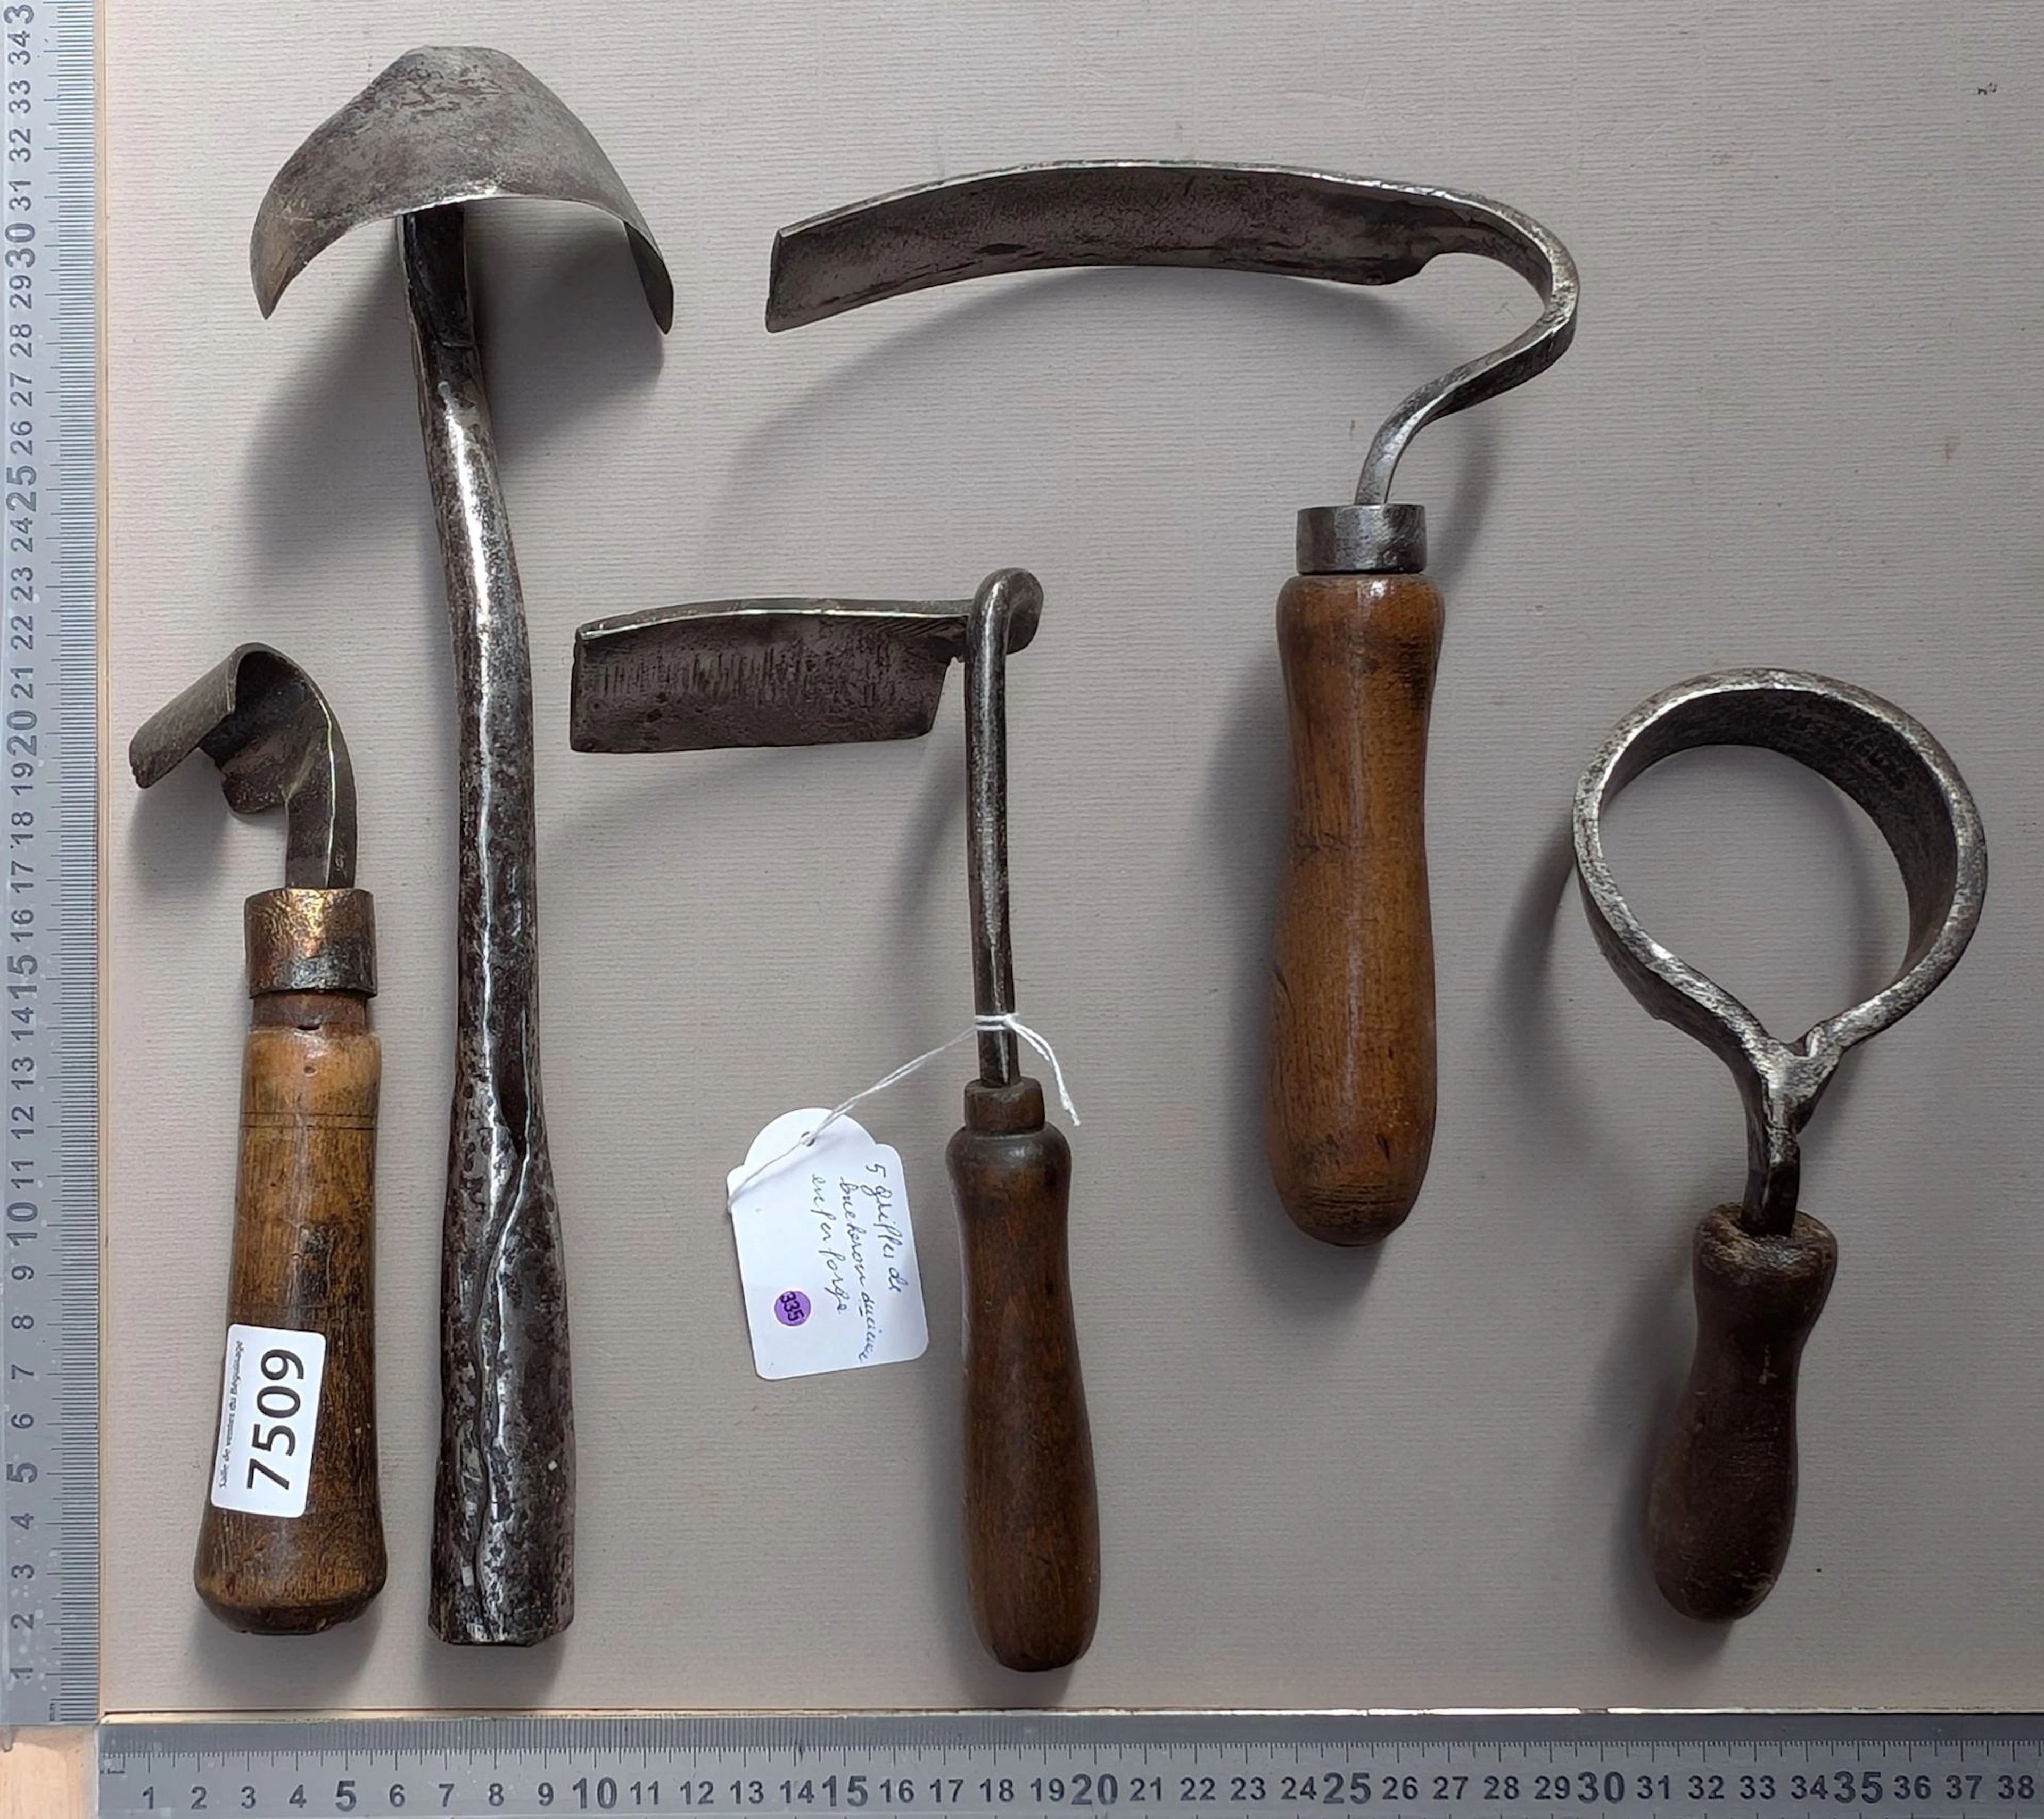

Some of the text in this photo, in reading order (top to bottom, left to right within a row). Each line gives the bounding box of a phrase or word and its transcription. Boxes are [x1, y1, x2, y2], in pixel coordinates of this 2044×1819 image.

[7, 30, 31, 65] 34
[8, 80, 31, 114] 33
[8, 128, 31, 163] 32
[8, 180, 32, 211] 31
[5, 222, 36, 268] 30
[9, 275, 32, 309] 29
[9, 324, 32, 358] 28
[9, 372, 32, 407] 27
[10, 420, 33, 456] 26
[6, 465, 37, 512] 25
[10, 517, 34, 553] 24
[10, 567, 34, 601] 23
[11, 615, 34, 650] 22
[10, 668, 34, 699] 21
[6, 710, 37, 757] 20
[10, 762, 34, 796] 19
[10, 811, 34, 845] 18
[10, 860, 35, 894] 17
[10, 909, 34, 943] 16
[6, 954, 38, 1000] 15
[10, 1006, 34, 1041] 14
[10, 1056, 35, 1090] 13
[10, 1106, 35, 1140] 12
[10, 1161, 34, 1189] 11
[865, 1163, 886, 1178] 5
[6, 1202, 38, 1246] 10
[11, 1265, 35, 1281] 9
[11, 1314, 34, 1330] 8
[779, 1291, 805, 1321] 335
[11, 1364, 34, 1380] 7
[229, 1397, 237, 1410] du
[246, 1349, 304, 1491] 7509
[10, 1413, 34, 1429] 6
[226, 1413, 235, 1446] ventes
[222, 1448, 231, 1462] de
[6, 1462, 38, 1483] 5
[219, 1464, 229, 1488] Salle
[10, 1513, 34, 1531] 4
[10, 1564, 35, 1580] 3
[10, 1614, 34, 1630] 2
[10, 1668, 34, 1679] 1
[142, 1772, 2035, 1812] 1 2 3 4 5 6 7 8 9 10 11 12 13 14 15 16 17 18 19 20 21 22 23 24 25 26 27 28 29 30 31 32 33 34 35 36 37 38
